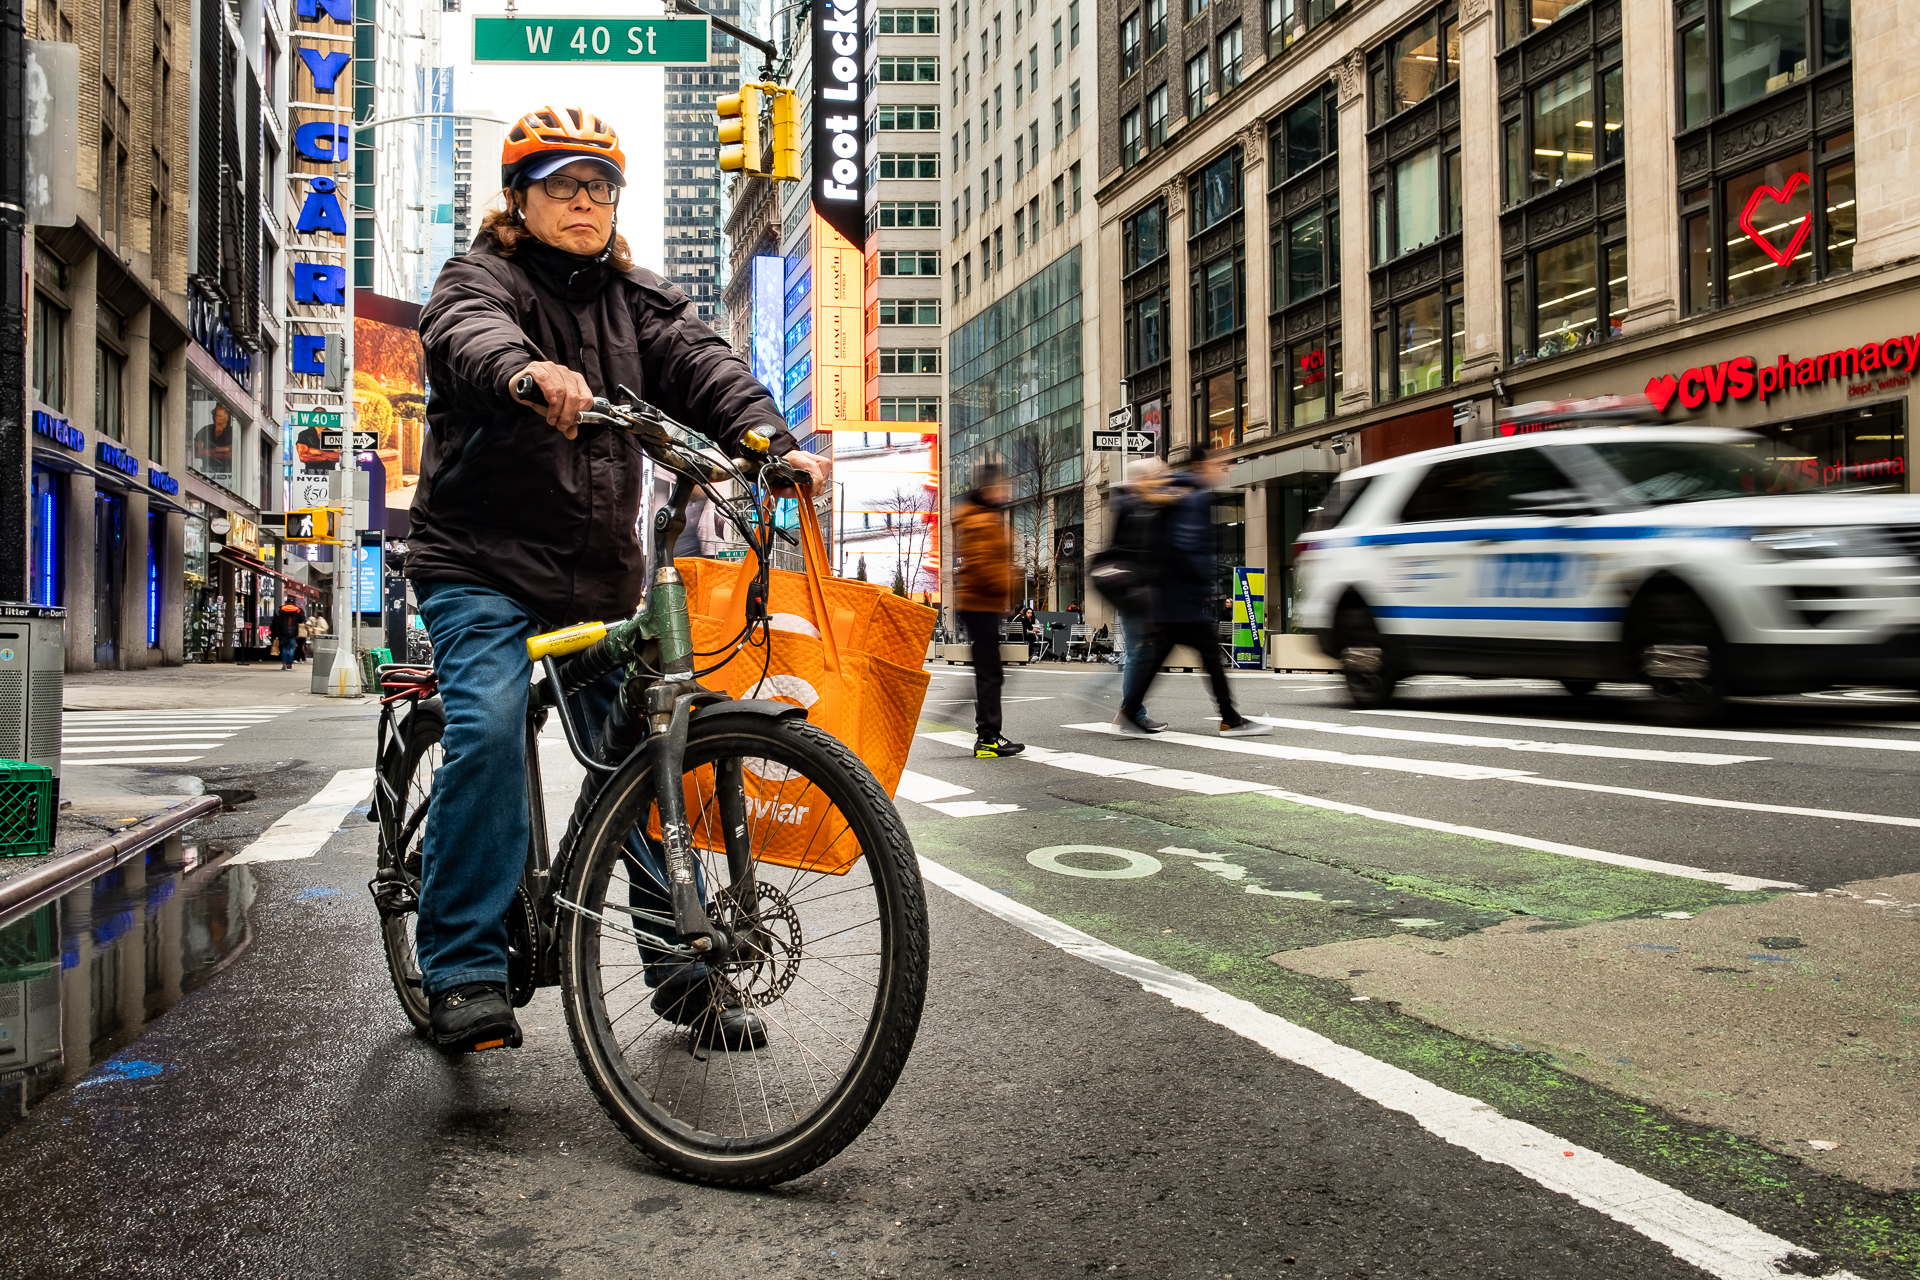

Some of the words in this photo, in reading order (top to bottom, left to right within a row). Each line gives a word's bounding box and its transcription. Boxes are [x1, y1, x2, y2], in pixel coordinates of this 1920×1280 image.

[525, 26, 553, 53] W
[570, 26, 611, 54] 40
[627, 26, 657, 54] St
[823, 115, 858, 200] Foot
[1310, 348, 1324, 369] CV
[1678, 356, 1754, 408] CVS
[1759, 332, 1920, 402] pharmacy
[1847, 383, 1875, 397] dept.
[1878, 375, 1910, 391] within
[300, 413, 310, 424] W
[312, 414, 328, 425] 40
[1101, 437, 1119, 446] ONE
[1127, 438, 1146, 447] WAY
[1823, 456, 1905, 487] pharma
[309, 488, 328, 500] 50
[5, 608, 30, 616] litter
[1241, 580, 1259, 641] #GarmentDistrict
[744, 795, 810, 825] aviar
